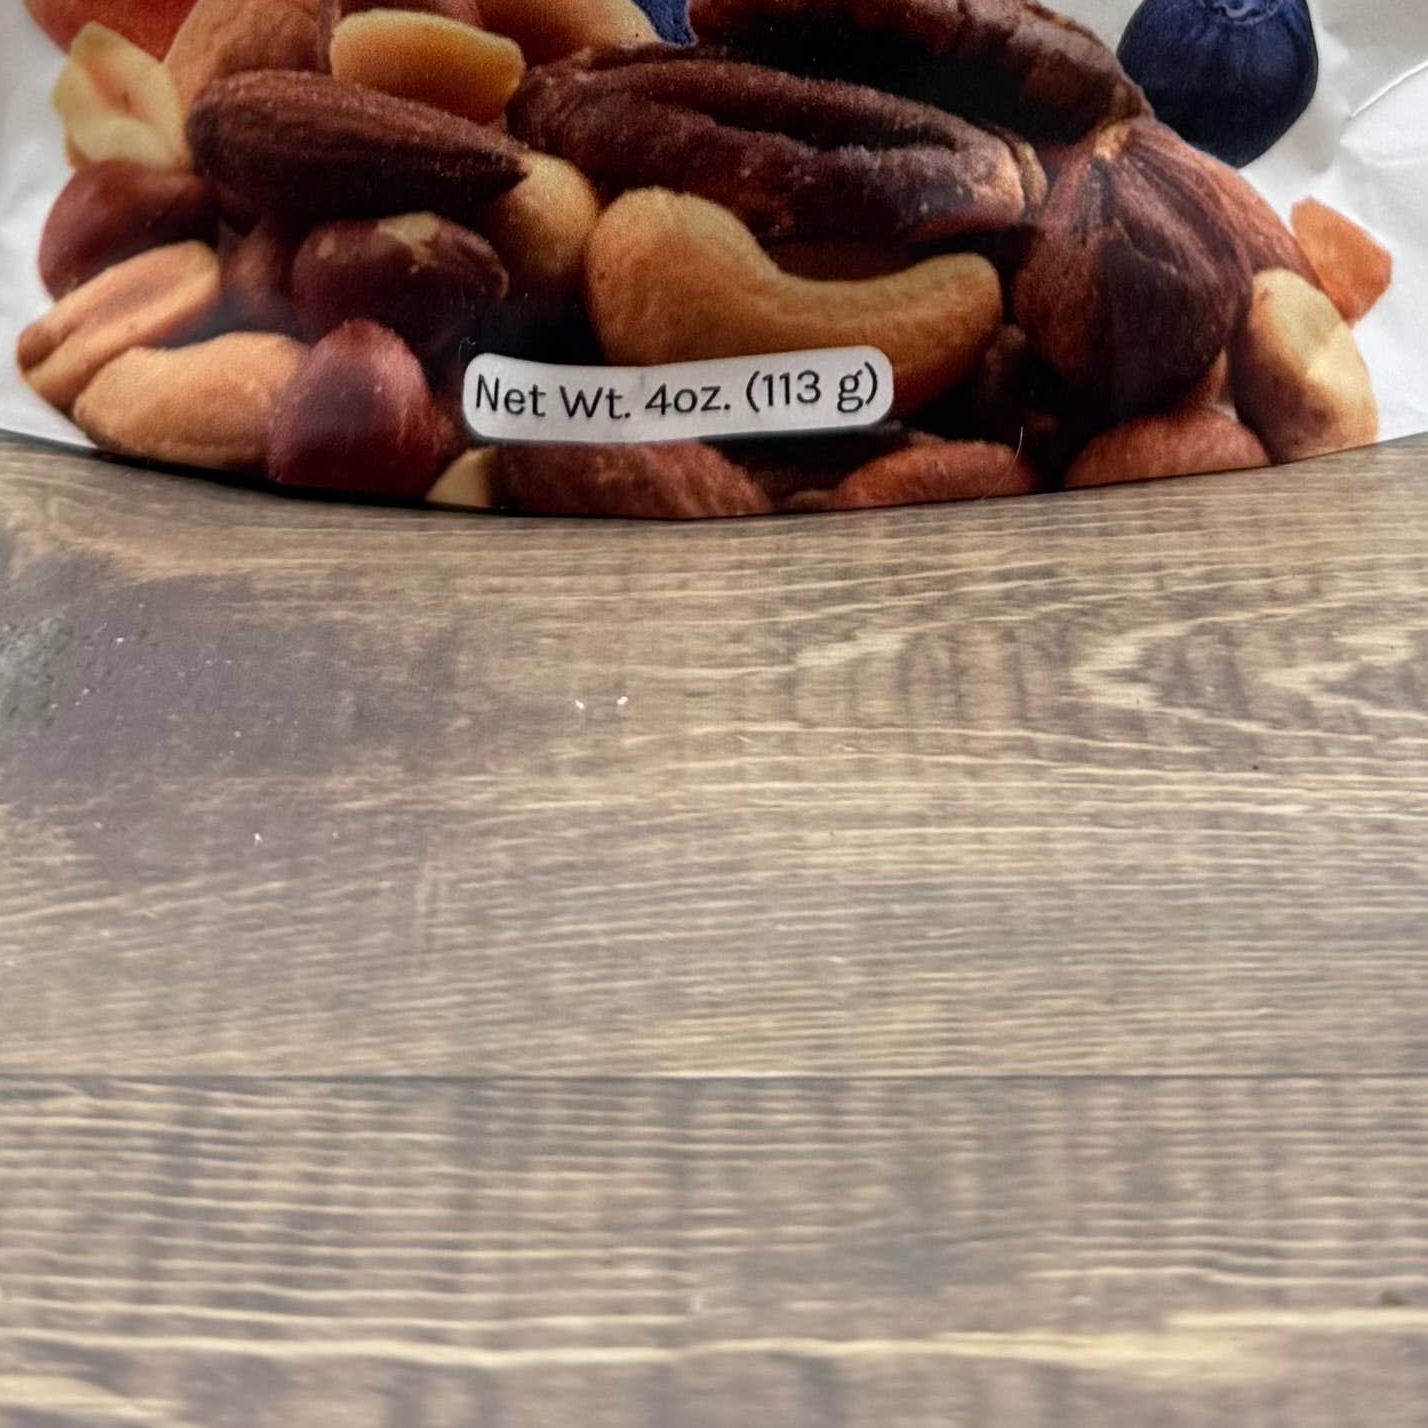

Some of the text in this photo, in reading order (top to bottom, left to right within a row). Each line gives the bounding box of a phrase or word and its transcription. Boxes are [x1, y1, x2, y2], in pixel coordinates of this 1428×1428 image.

[475, 361, 879, 420] Net Wt. 4oz. (113 g)
